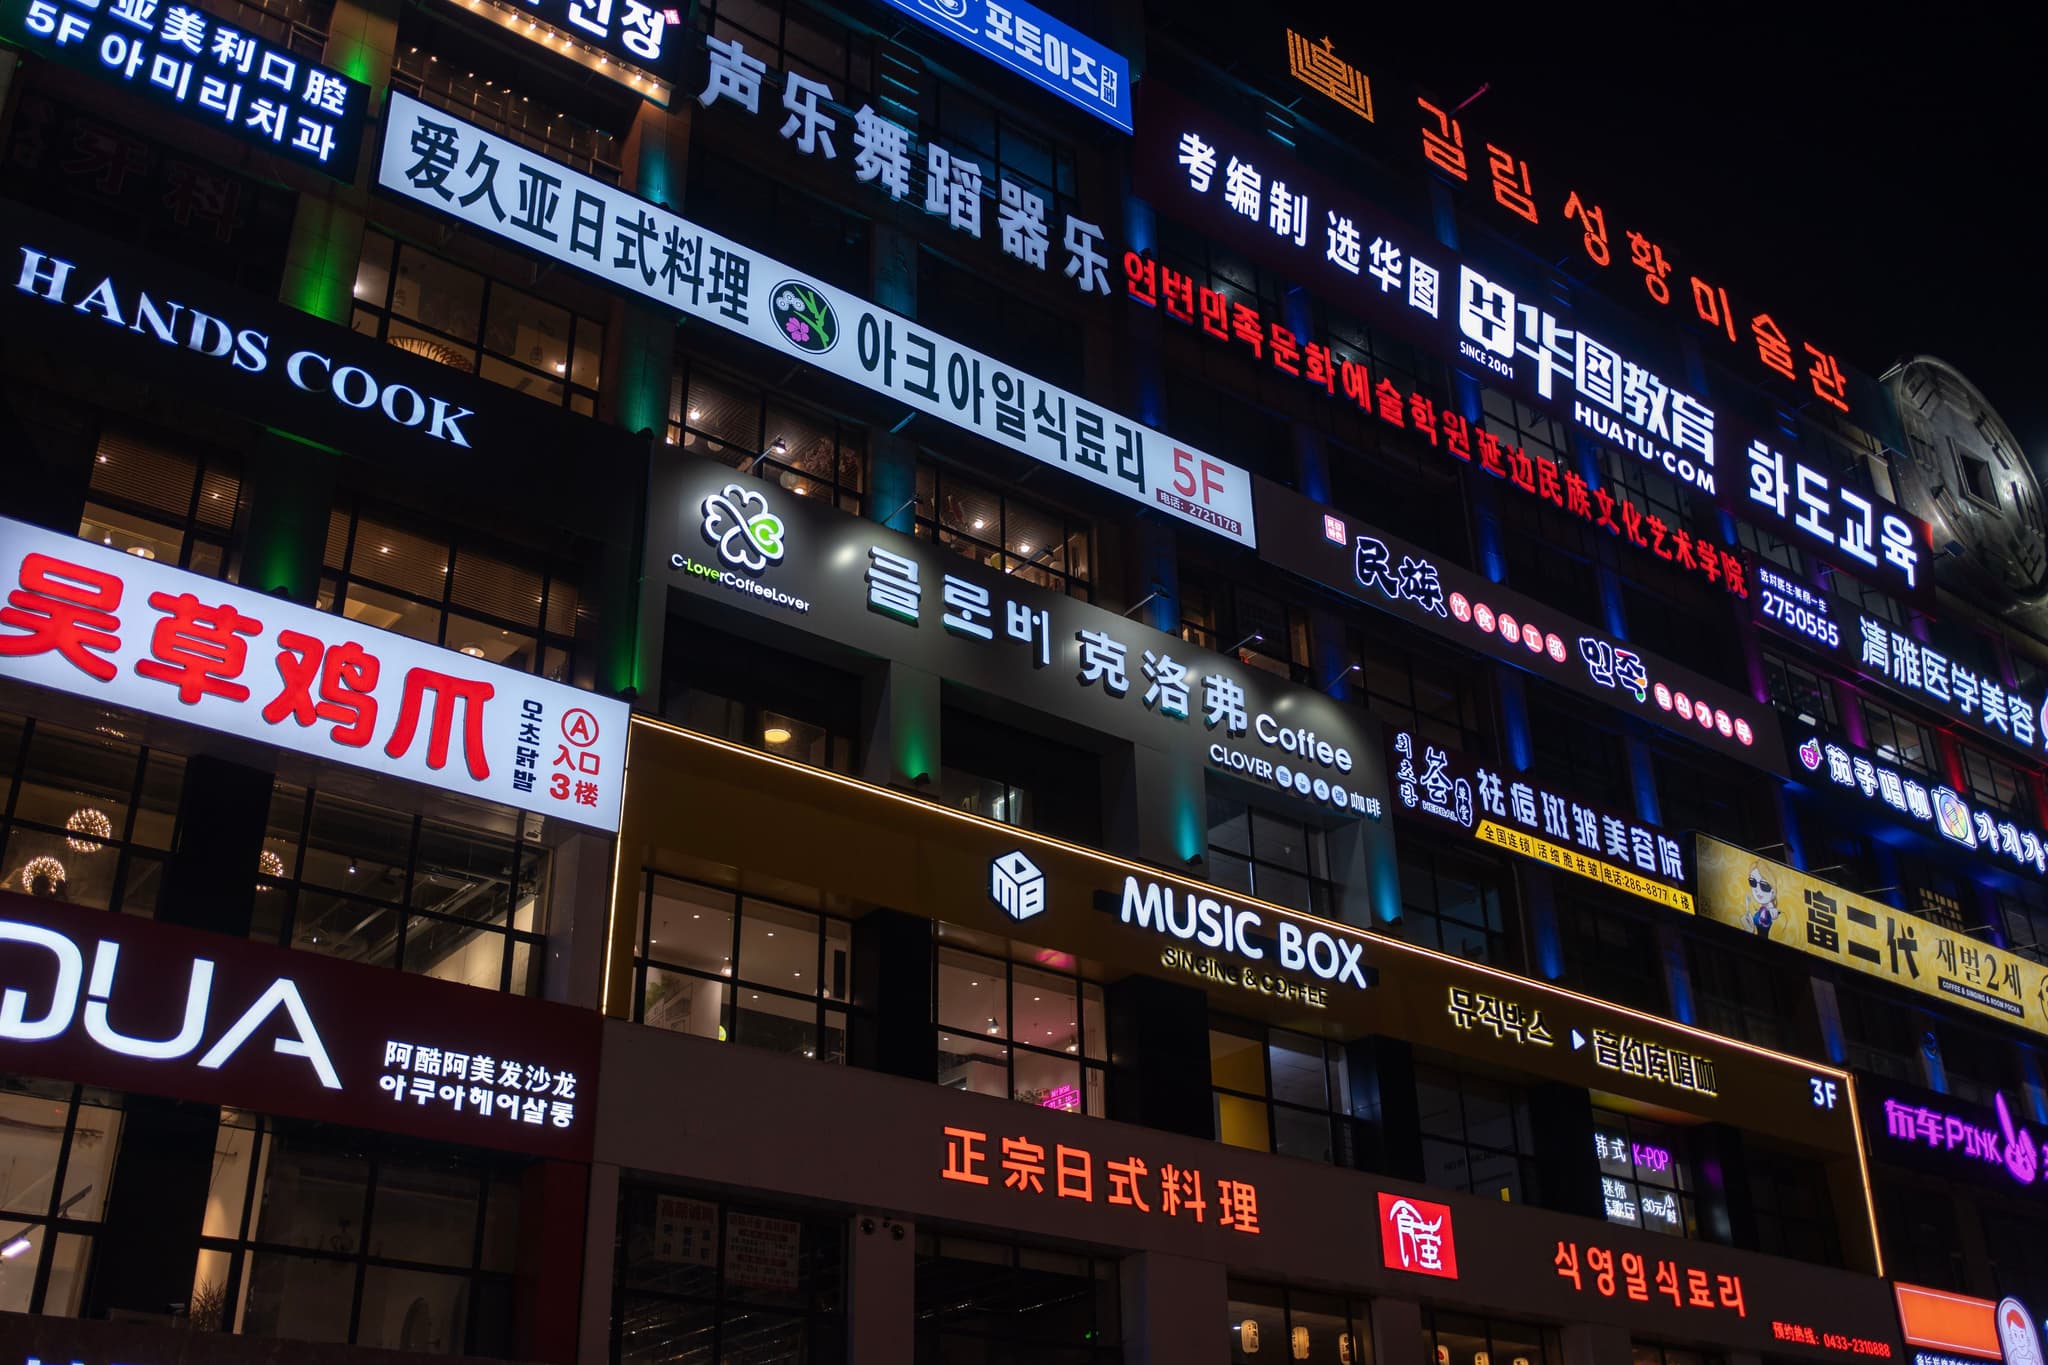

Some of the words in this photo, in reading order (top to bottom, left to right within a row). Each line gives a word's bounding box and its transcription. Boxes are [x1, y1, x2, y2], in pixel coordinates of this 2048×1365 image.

[26, 0, 91, 43] 5F
[101, 34, 336, 162] 아미리치과
[985, 0, 1099, 97] 포토이즈
[1102, 66, 1116, 106] 카페
[699, 34, 1112, 296] 声乐舞蹈器乐
[1179, 133, 1308, 247] 考编制
[1326, 210, 1439, 320] 选华图
[13, 246, 269, 373] HANDS
[286, 350, 473, 449] COOK
[404, 116, 751, 326] 爱久亚日式料理
[857, 312, 1146, 494] 아크아일식료리
[1173, 447, 1225, 505] 5F
[1459, 341, 1487, 365] SINCE
[1487, 356, 1514, 379] 2001
[1516, 302, 1715, 467] 华图教育
[1189, 503, 1239, 534] 2721178
[1475, 427, 1749, 600] 延边民族文化艺术学院
[1748, 440, 1917, 590] 화도교육
[671, 553, 810, 612] C-LoverCoffeeLover
[1355, 535, 1448, 618] 民族
[1451, 594, 1566, 660] 饮食加工部
[1762, 590, 1839, 647] 2750555
[0, 552, 495, 781] 吴草鸡爪
[1079, 628, 1248, 732] 克洛弗
[1255, 713, 1353, 771] Coffee
[1860, 615, 2035, 746] 清雅医学美容
[549, 772, 598, 807] 3楼
[552, 744, 600, 775] 入口
[1210, 744, 1273, 780] CLOVER
[1351, 791, 1382, 818] 咖啡
[1825, 744, 1932, 820] 茄子唱咖
[1973, 812, 2048, 873] 가지가
[1476, 767, 1685, 882] 祛痘斑皱美容院
[1484, 824, 1530, 853] 全国连锁
[1537, 842, 1599, 878] 活细胞祛皱
[1121, 875, 1264, 960] MUSIC
[1278, 921, 1368, 990] BOX
[1160, 946, 1239, 984] SINGING
[1244, 966, 1257, 987] &
[1260, 972, 1330, 1009] COFFEE
[1803, 888, 1920, 980] 富二代
[1935, 936, 2023, 1000] 재벌2세
[1448, 987, 1554, 1046] 뮤직박스
[1942, 980, 1961, 993] COFFEE
[379, 1074, 575, 1128] 아쿠아헤어살롱
[384, 1040, 577, 1099] 阿酷阿美发沙龙
[1810, 1078, 1837, 1109] 3F
[942, 1125, 1260, 1234] 正宗日式料理
[1632, 1143, 1669, 1171] K-POP
[1553, 1240, 1746, 1318] 식영일식료리
[1823, 1333, 1891, 1359] 0433-2310888
